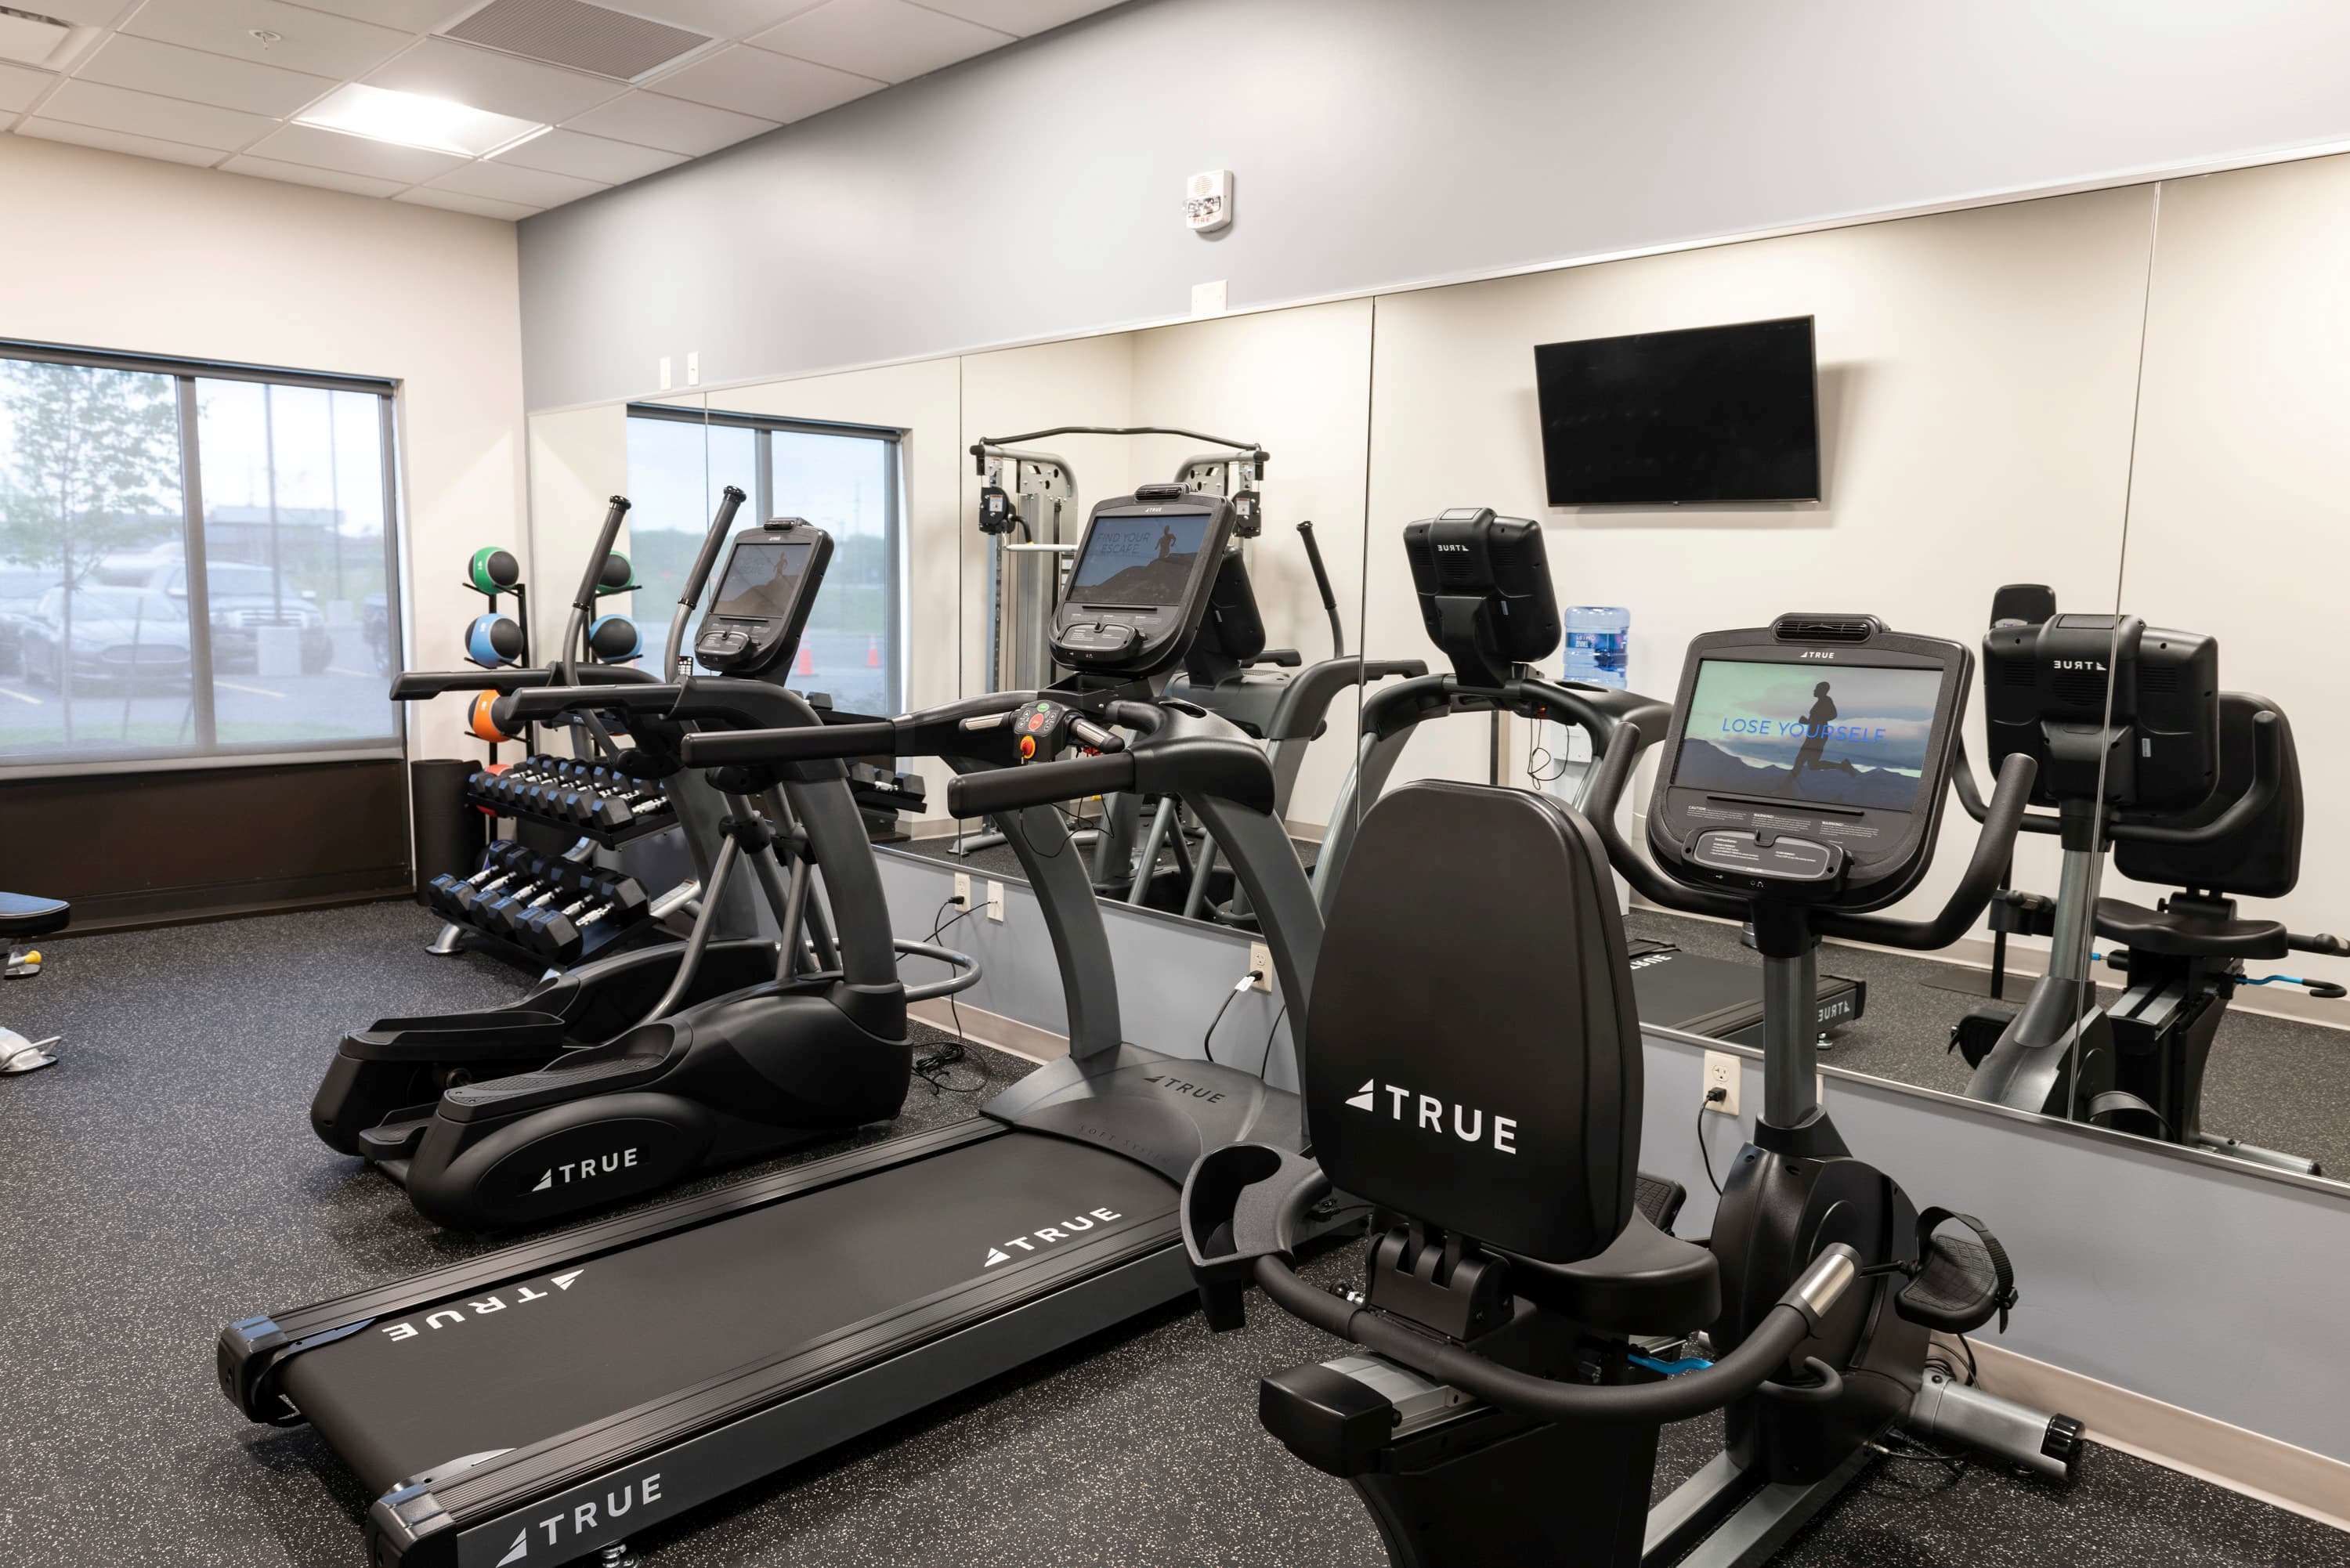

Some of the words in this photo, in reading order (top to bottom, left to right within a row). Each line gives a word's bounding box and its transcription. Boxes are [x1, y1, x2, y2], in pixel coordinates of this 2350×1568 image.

[1097, 533, 1120, 542] FIND
[1125, 533, 1151, 542] YOUR
[1723, 717, 1772, 735] LOSE
[1779, 721, 1886, 742] YOURSELF
[1163, 1078, 1226, 1104] TRUE
[1385, 1084, 1517, 1154] TRUE
[559, 1148, 638, 1183] TRUE
[1003, 1207, 1123, 1251] TRUE
[381, 1287, 548, 1342] TRUE
[539, 1472, 662, 1546] TRUE
